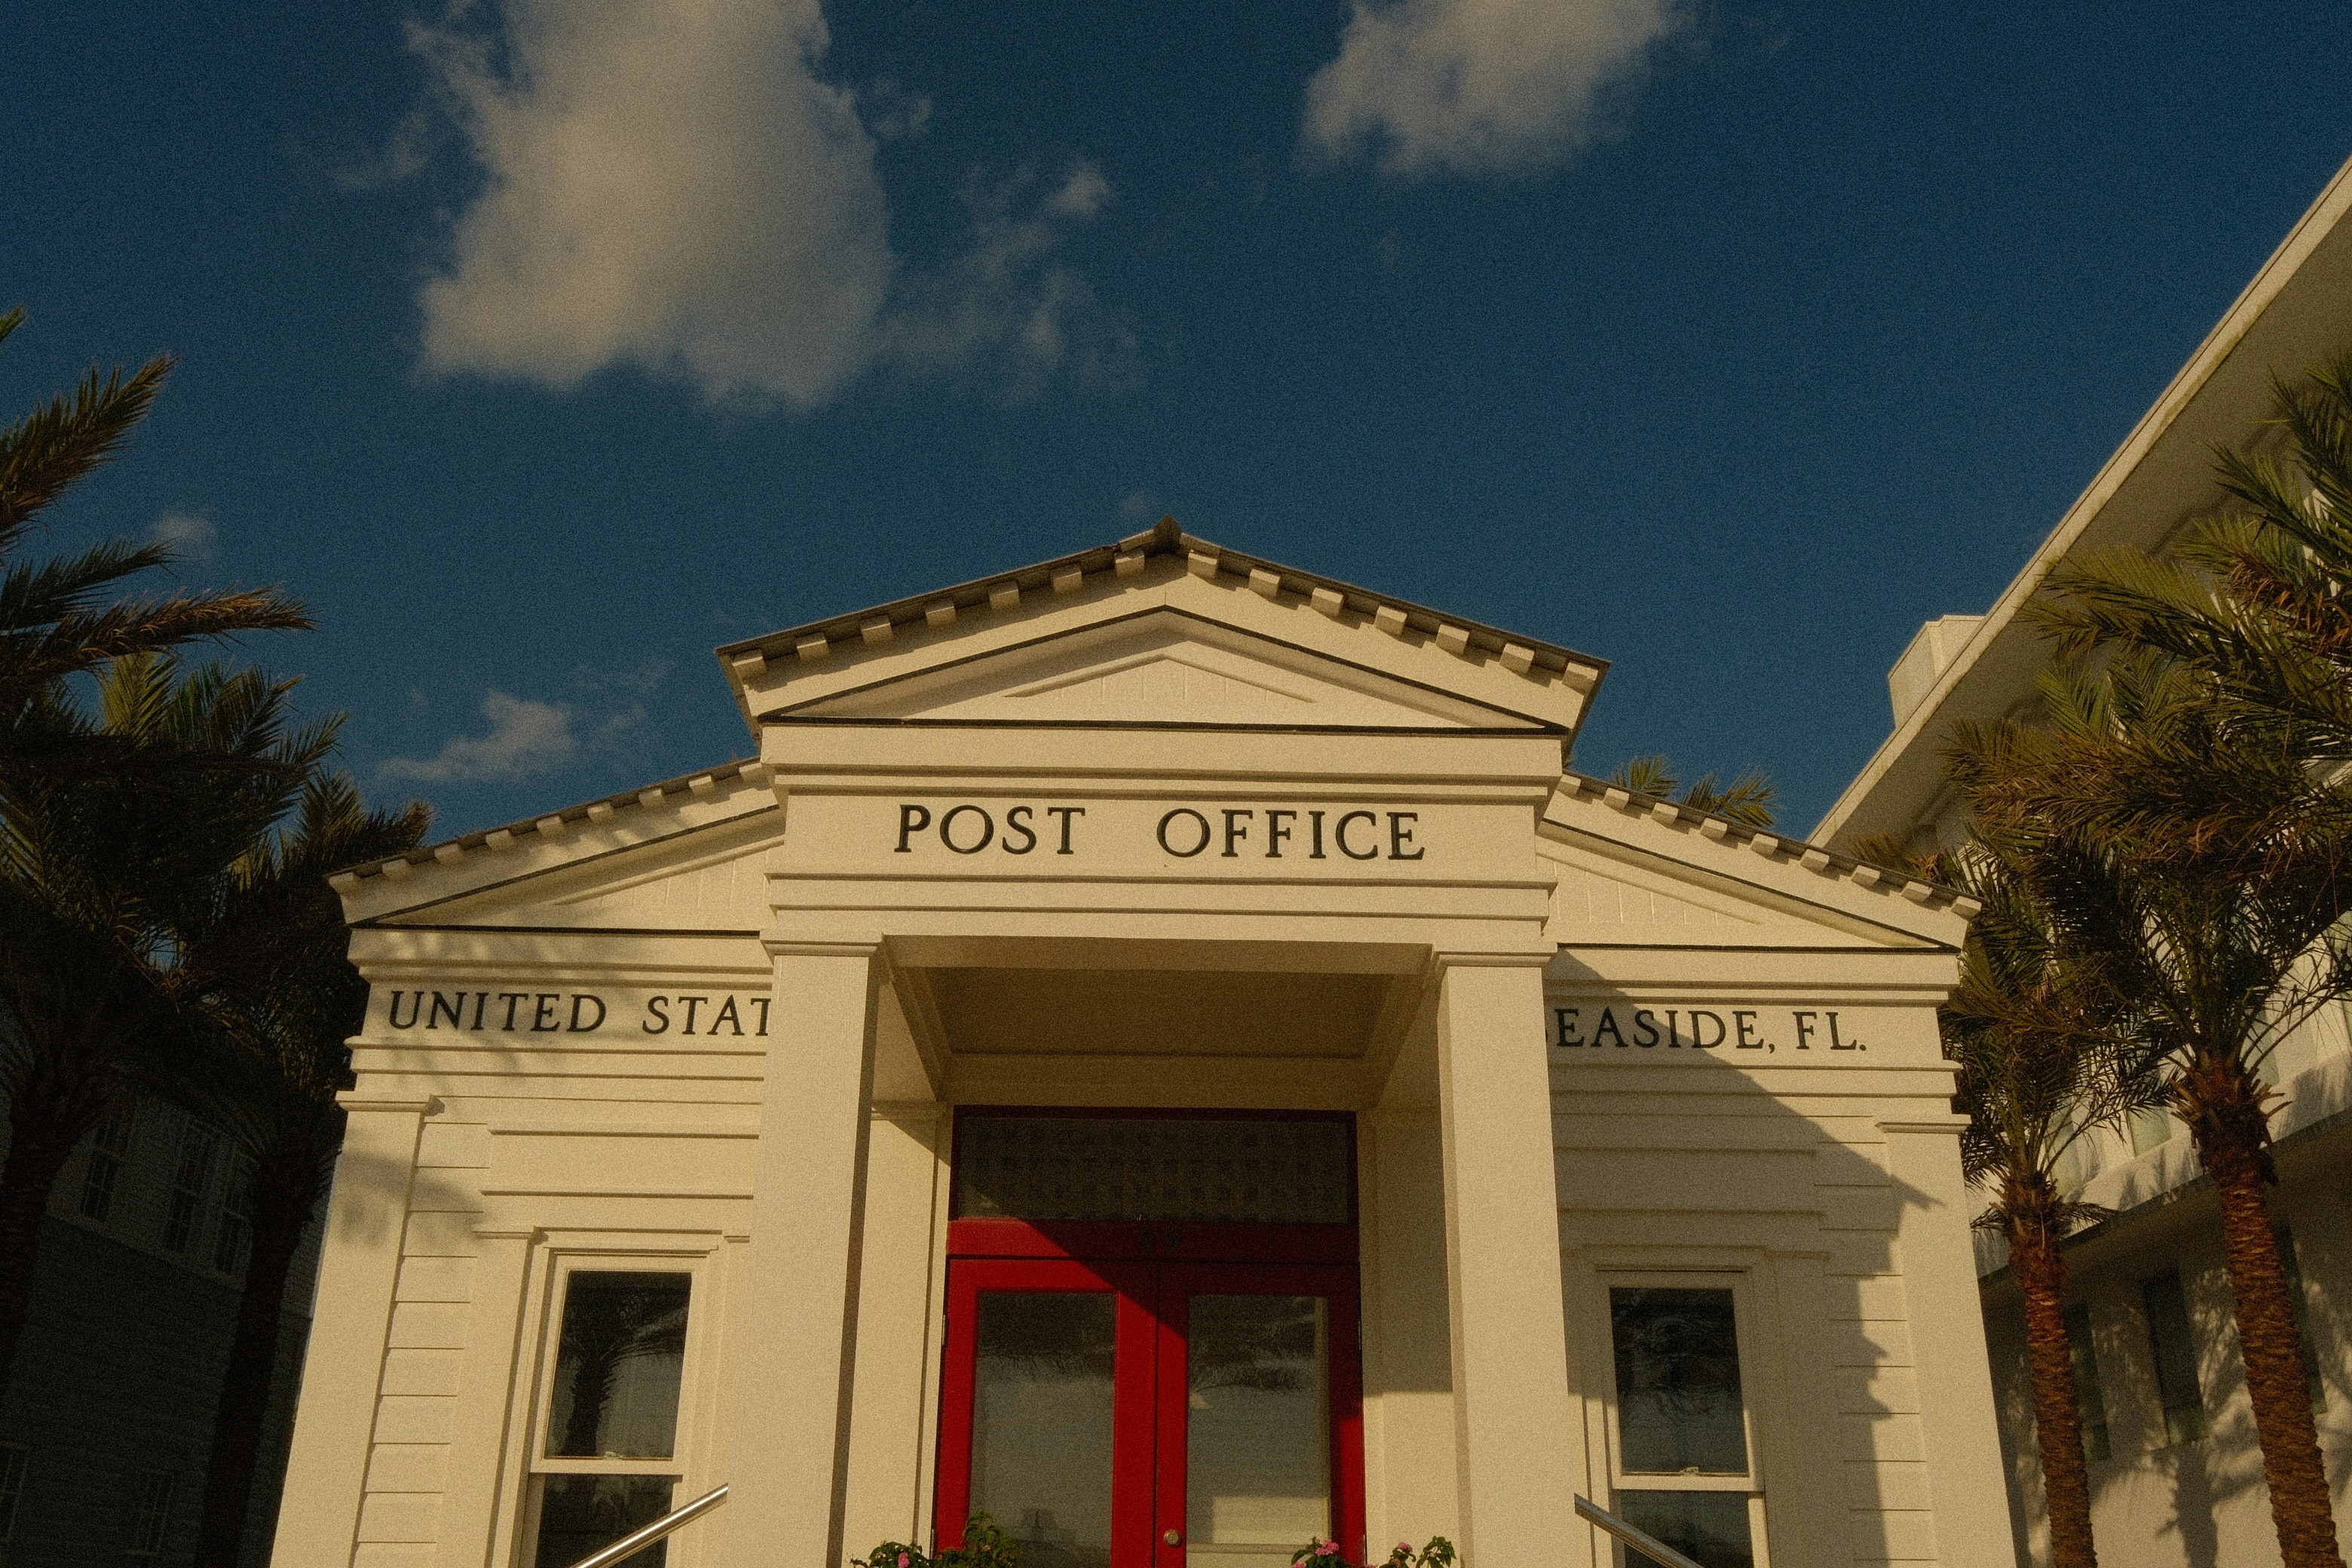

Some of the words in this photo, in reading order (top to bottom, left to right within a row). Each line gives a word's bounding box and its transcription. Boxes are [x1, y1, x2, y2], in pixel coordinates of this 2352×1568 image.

[894, 804, 1086, 855] POST
[1156, 807, 1426, 860] OFFICE
[388, 990, 607, 1032] UNITED
[1545, 1006, 1776, 1054] EASIDE,
[1793, 1011, 1867, 1051] FL.
